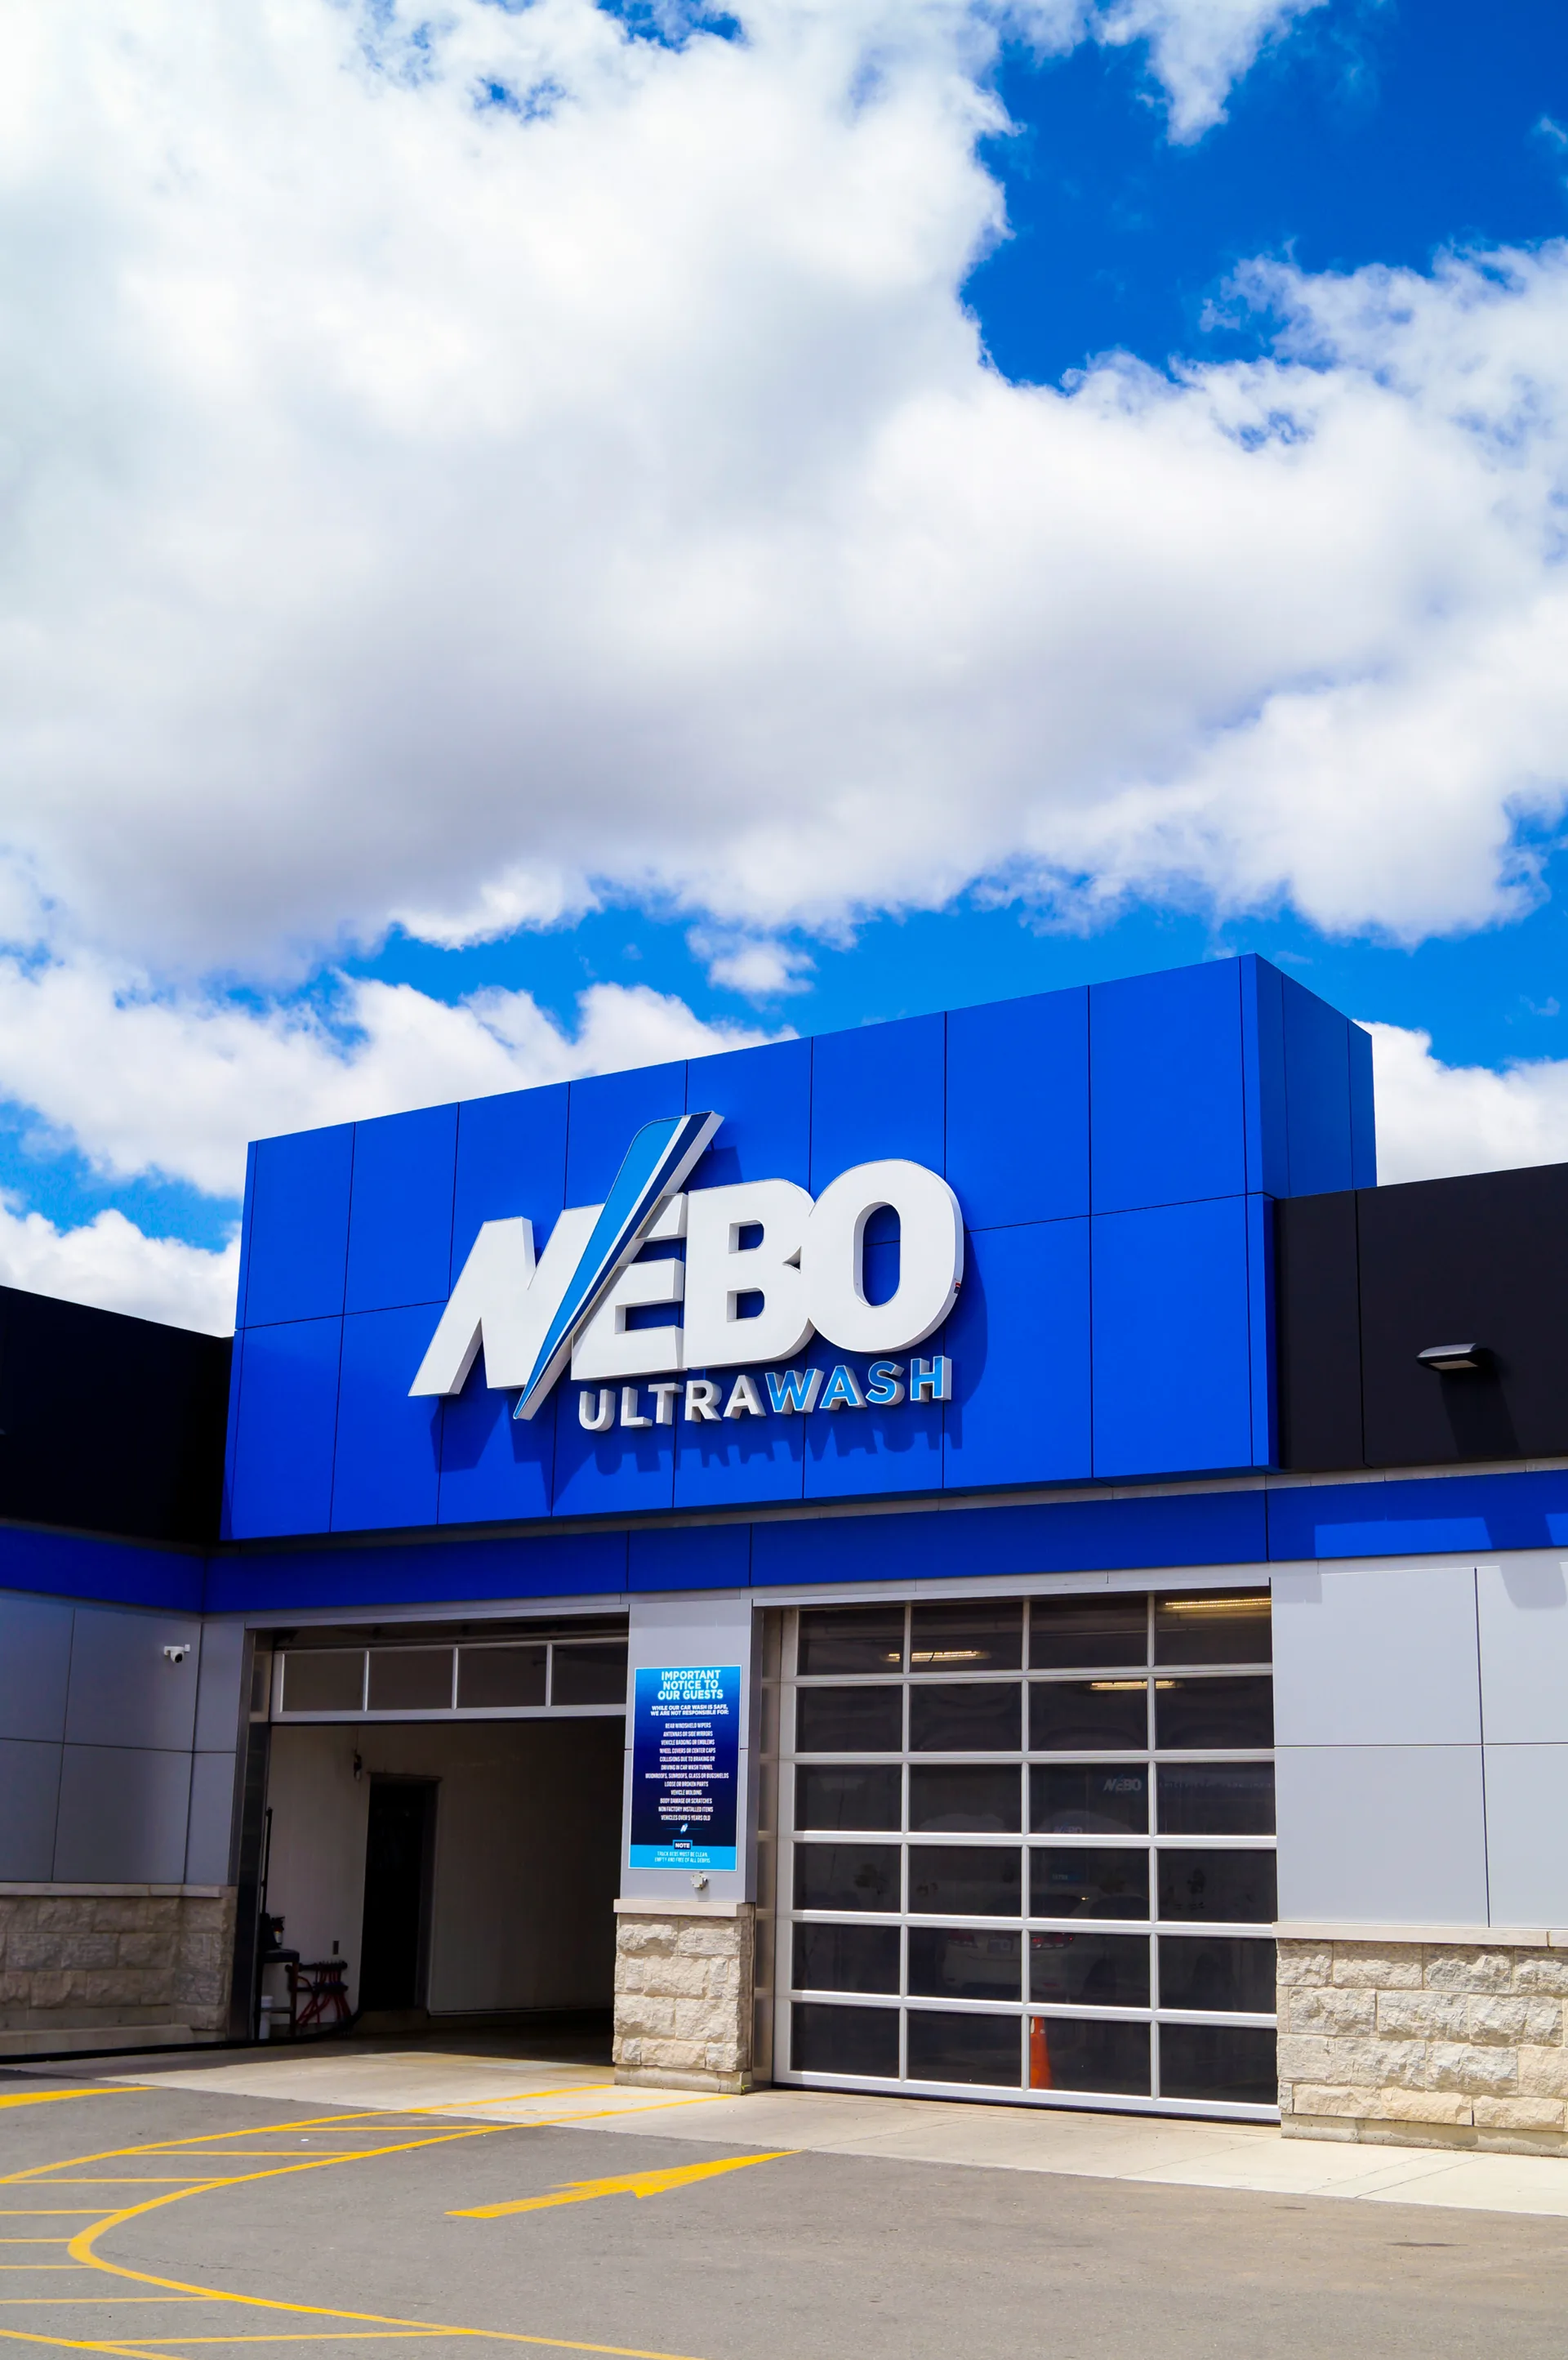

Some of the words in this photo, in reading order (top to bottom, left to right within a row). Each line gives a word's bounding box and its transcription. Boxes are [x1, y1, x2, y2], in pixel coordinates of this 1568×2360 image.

[408, 1153, 964, 1399] NEBO
[662, 1670, 721, 1680] IMPORTANT
[663, 1680, 702, 1690] NOTICE
[704, 1680, 719, 1689] TO
[657, 1690, 680, 1700] OUR
[683, 1689, 724, 1699] GUESTS
[1102, 1778, 1143, 1792] NEBO
